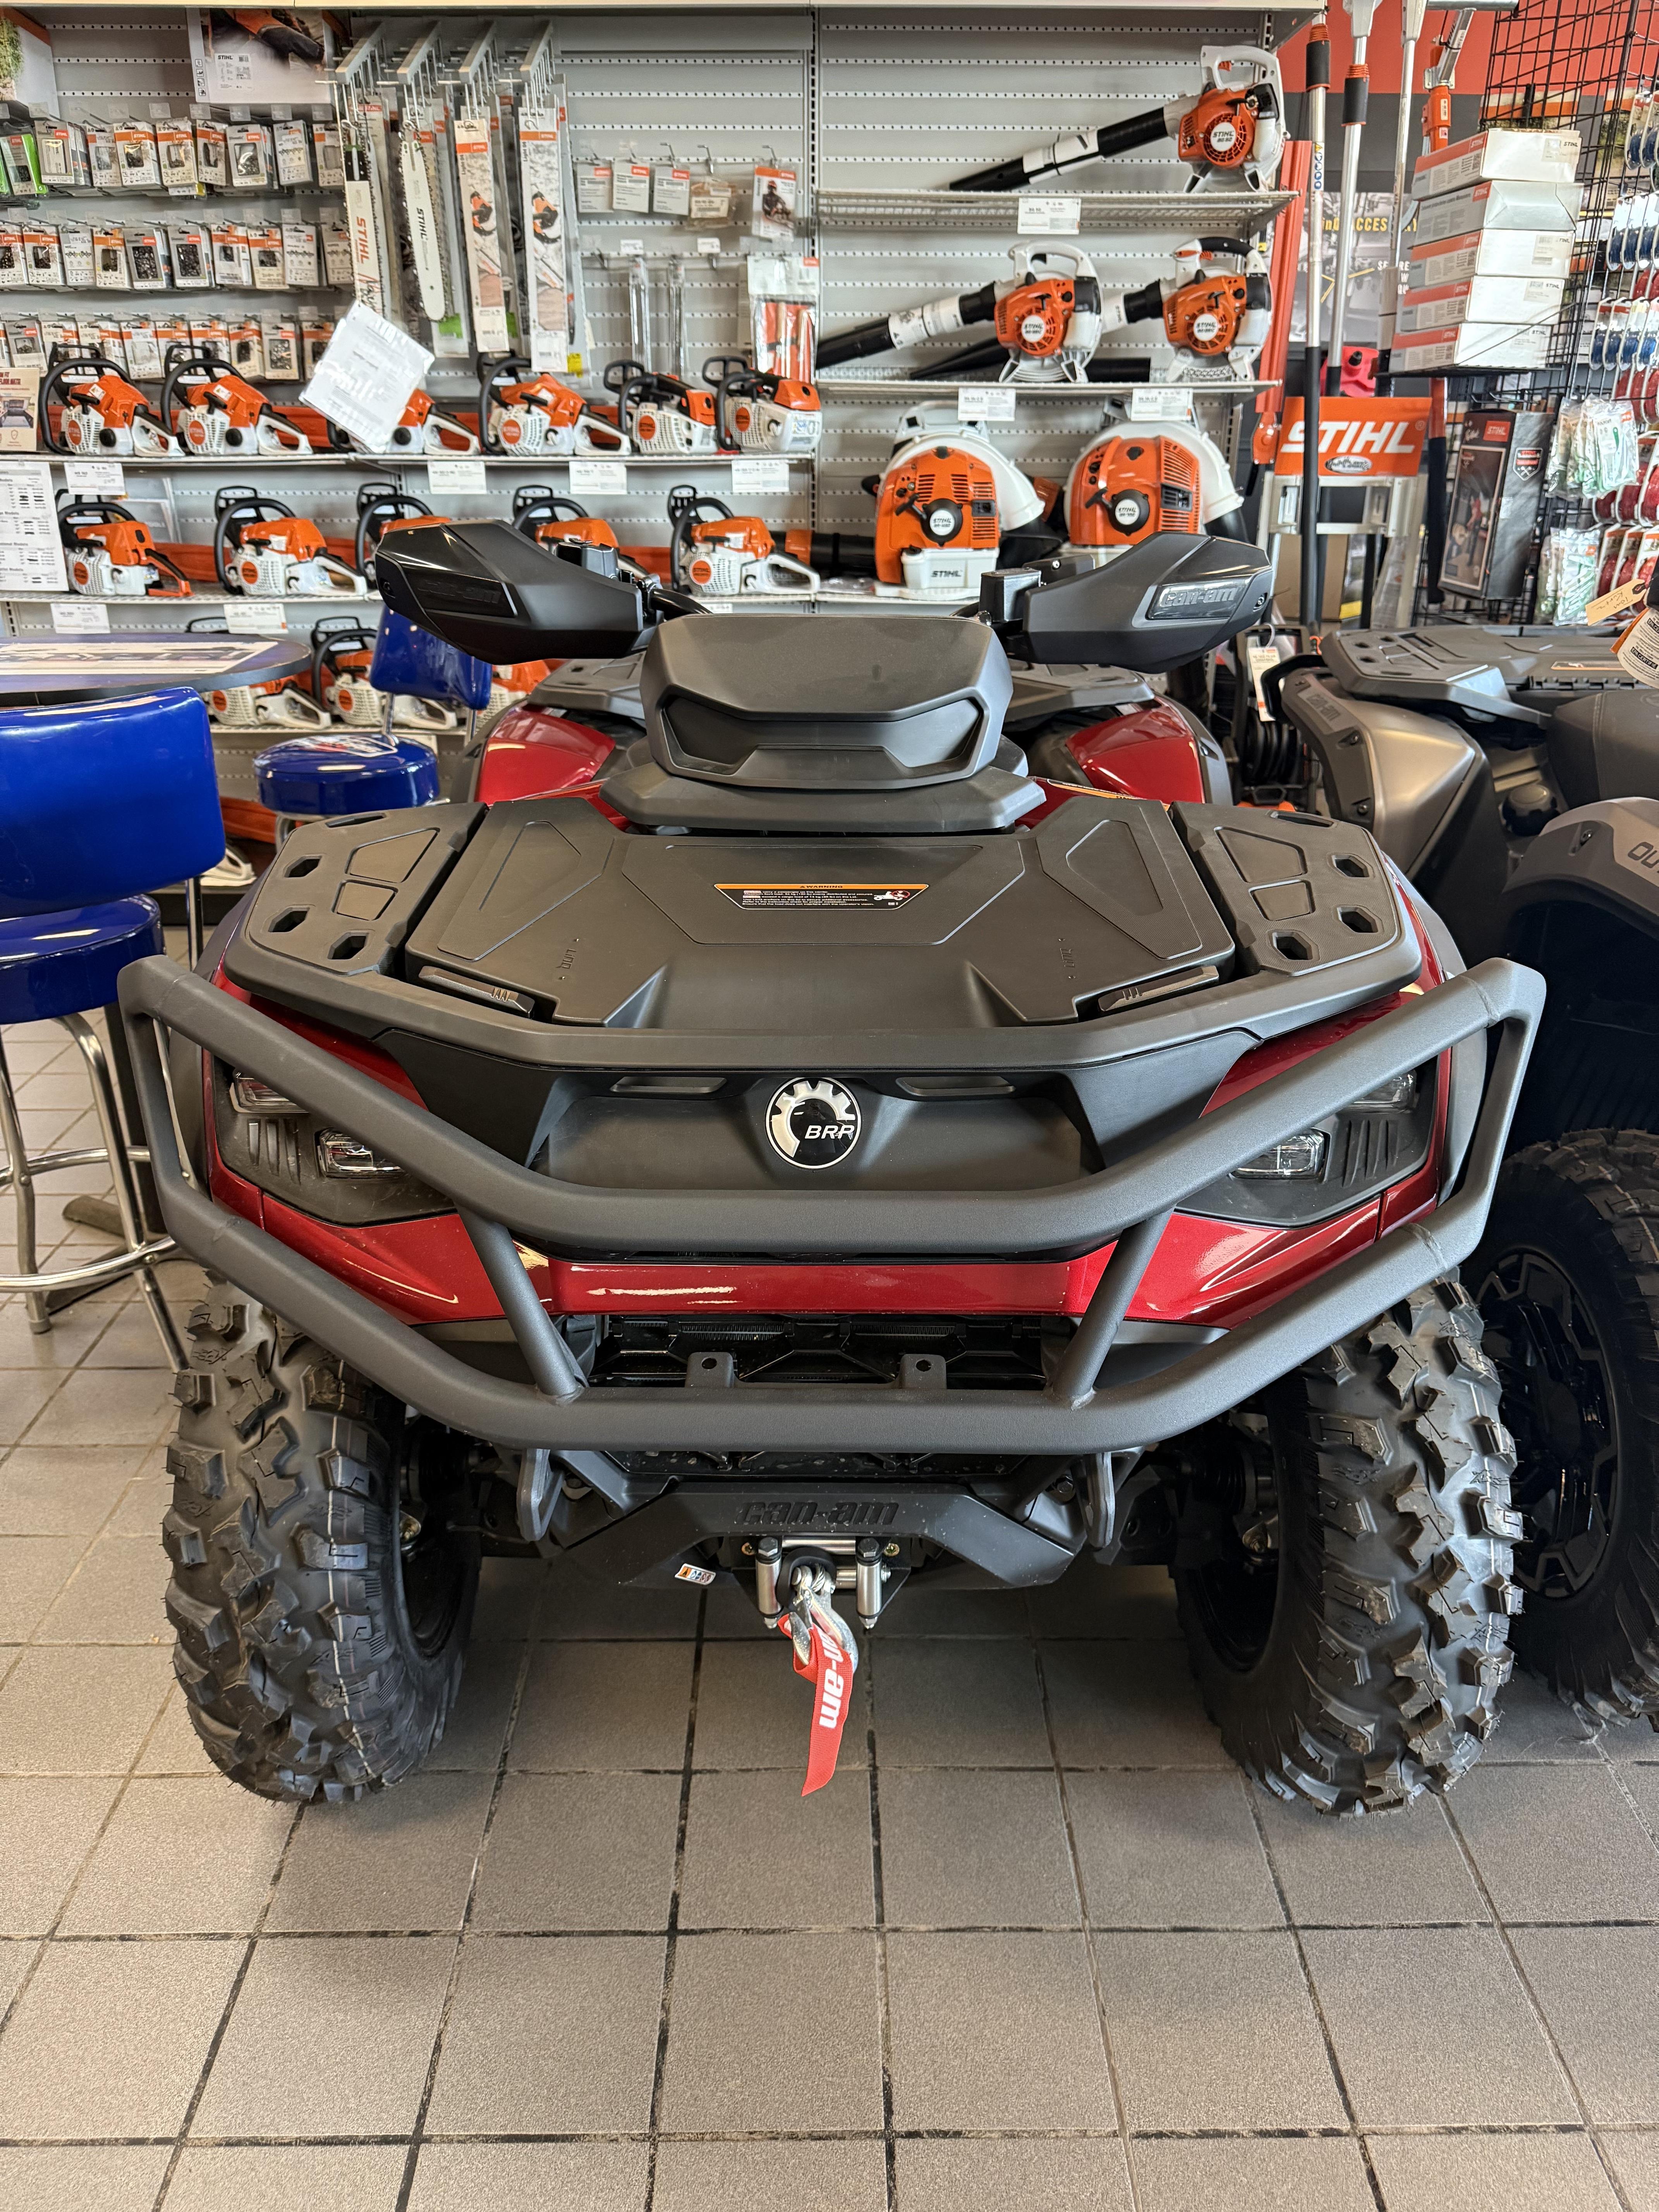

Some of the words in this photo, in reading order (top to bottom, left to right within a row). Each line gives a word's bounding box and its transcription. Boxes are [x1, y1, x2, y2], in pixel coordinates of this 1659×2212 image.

[1470, 138, 1484, 149] STIHL
[1474, 187, 1488, 198] STIHL
[416, 208, 428, 239] STIHL
[357, 216, 369, 264] STIHL
[1377, 261, 1410, 271] SERE
[1455, 285, 1468, 293] STIHL
[1280, 421, 1415, 453] STIHL
[1486, 425, 1507, 436] STIHL
[1159, 586, 1238, 607] can-am
[805, 1125, 855, 1140] BRP
[737, 1500, 900, 1525] can-am
